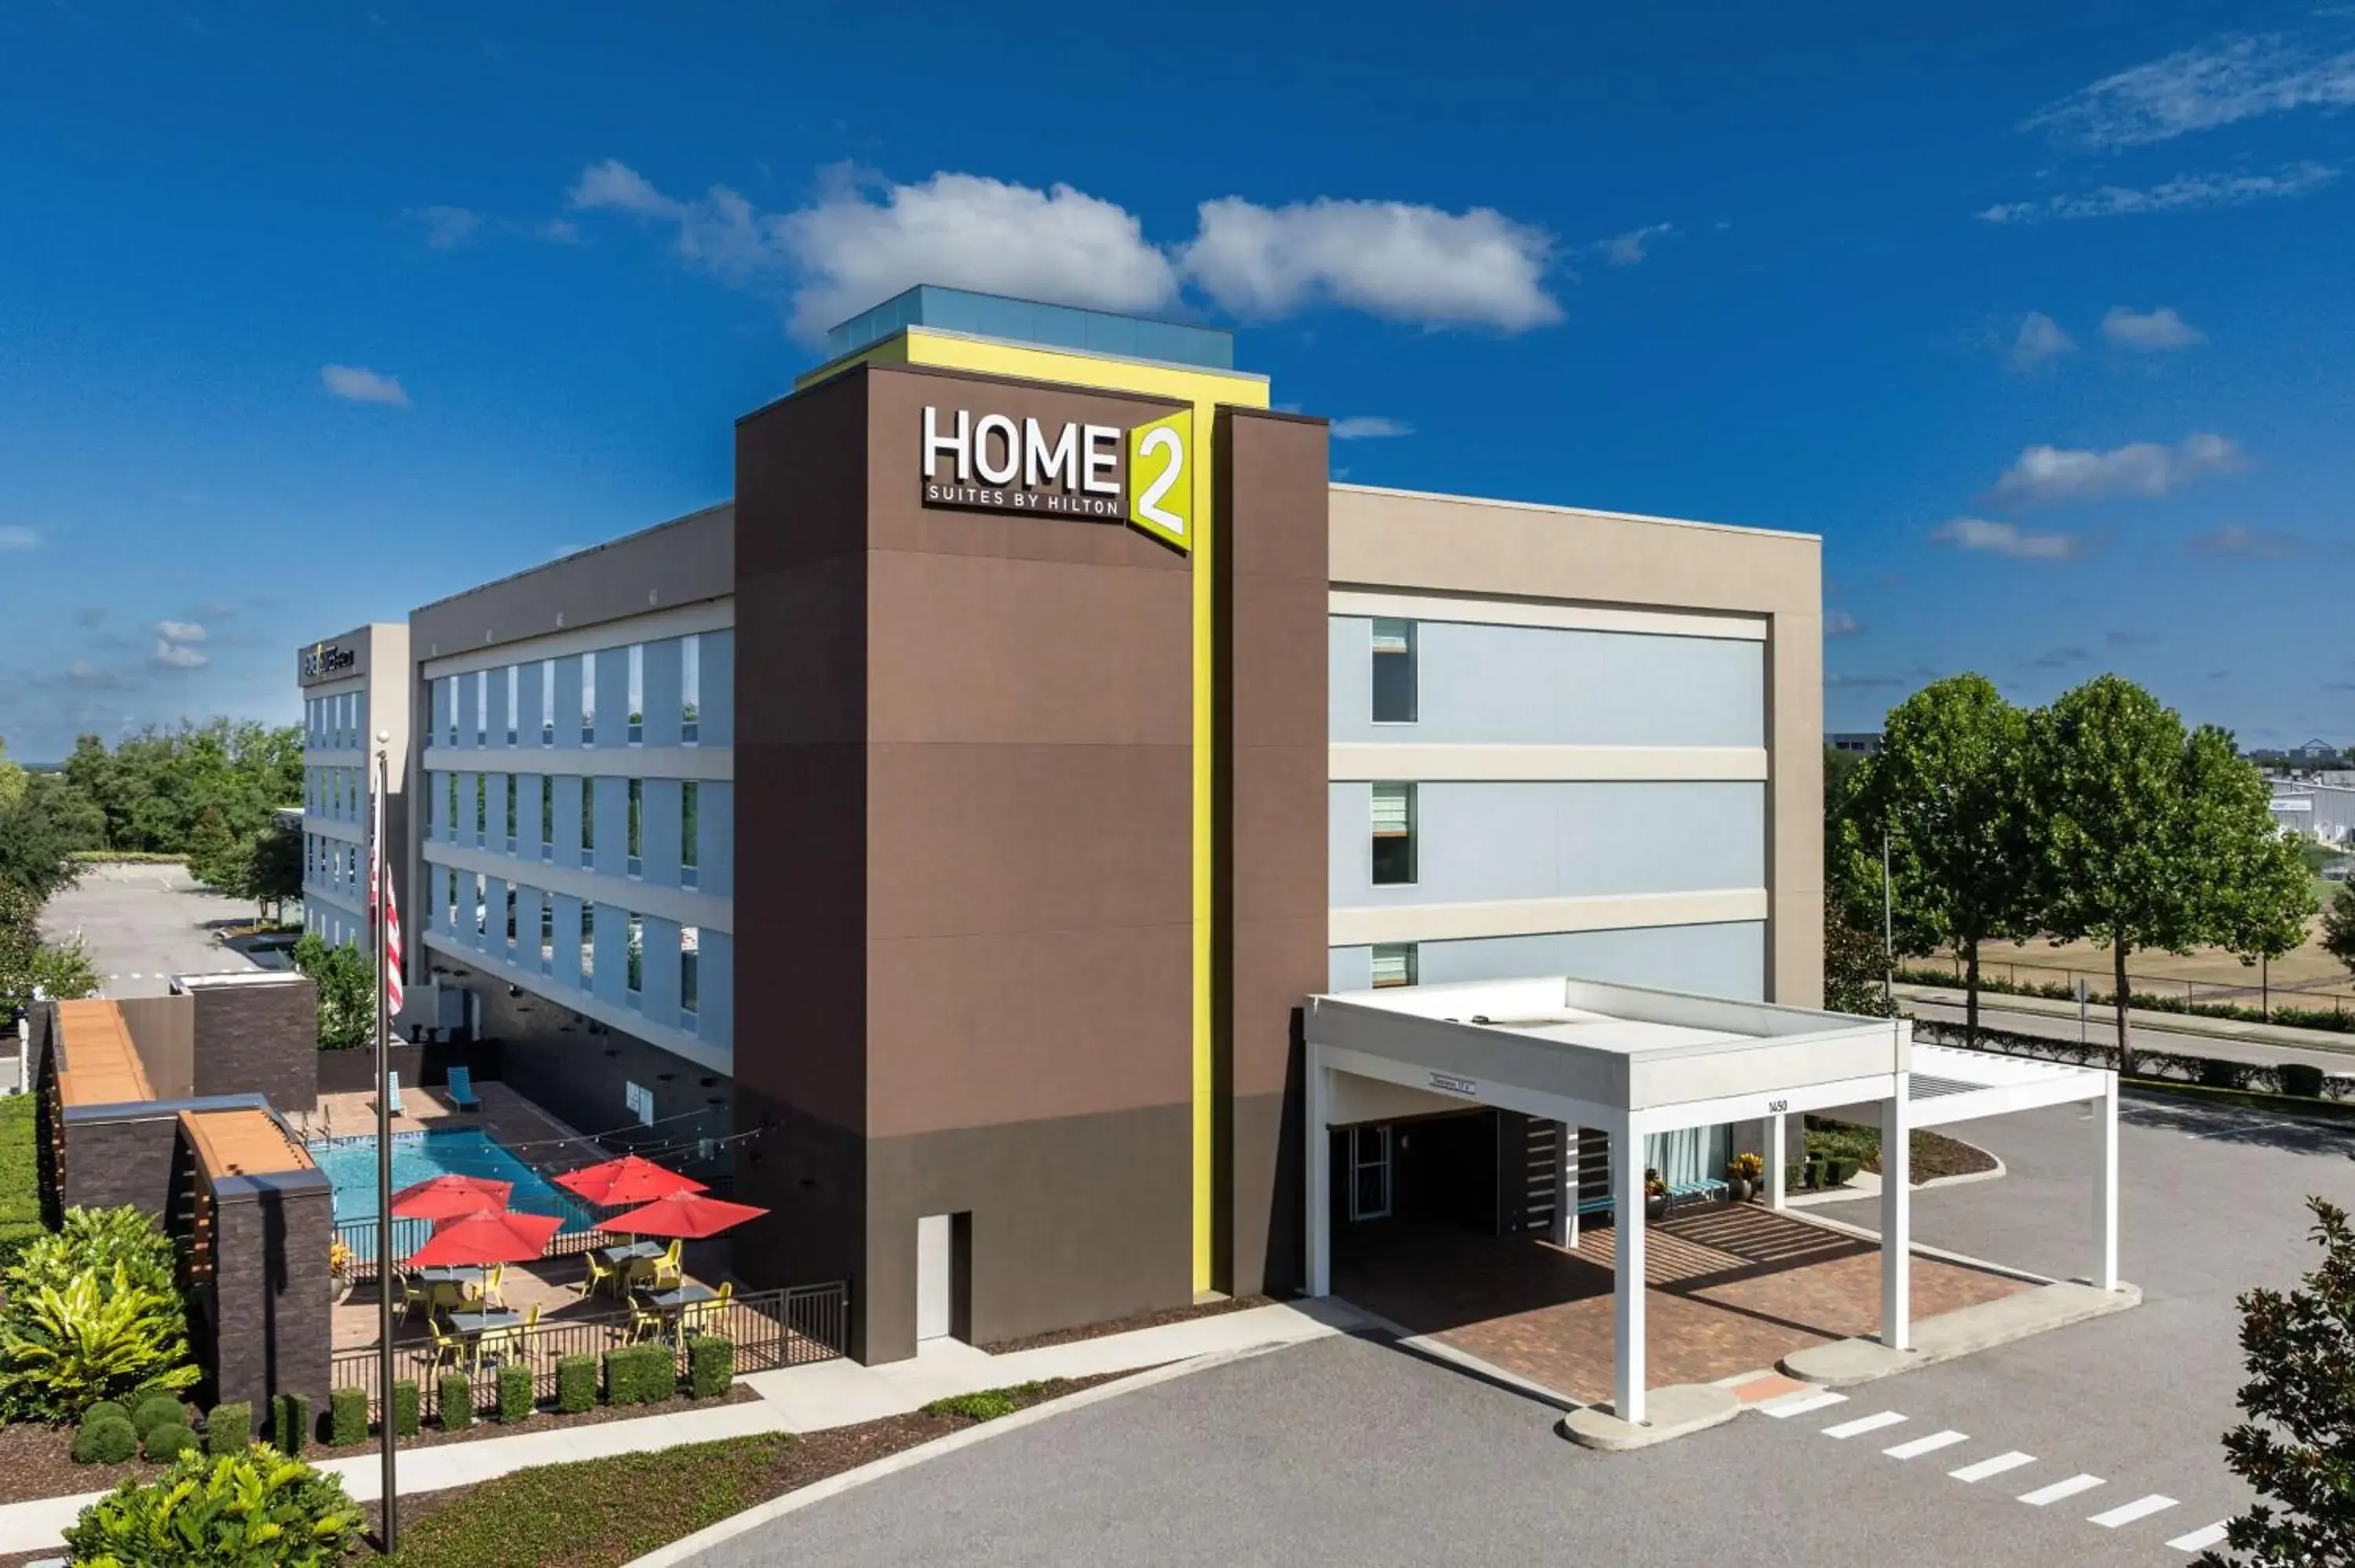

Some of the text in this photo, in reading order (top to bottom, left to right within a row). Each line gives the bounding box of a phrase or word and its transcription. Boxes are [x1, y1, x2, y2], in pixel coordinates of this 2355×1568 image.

[925, 406, 1184, 534] HOME 2
[929, 485, 1118, 515] SUITES BY HILTON
